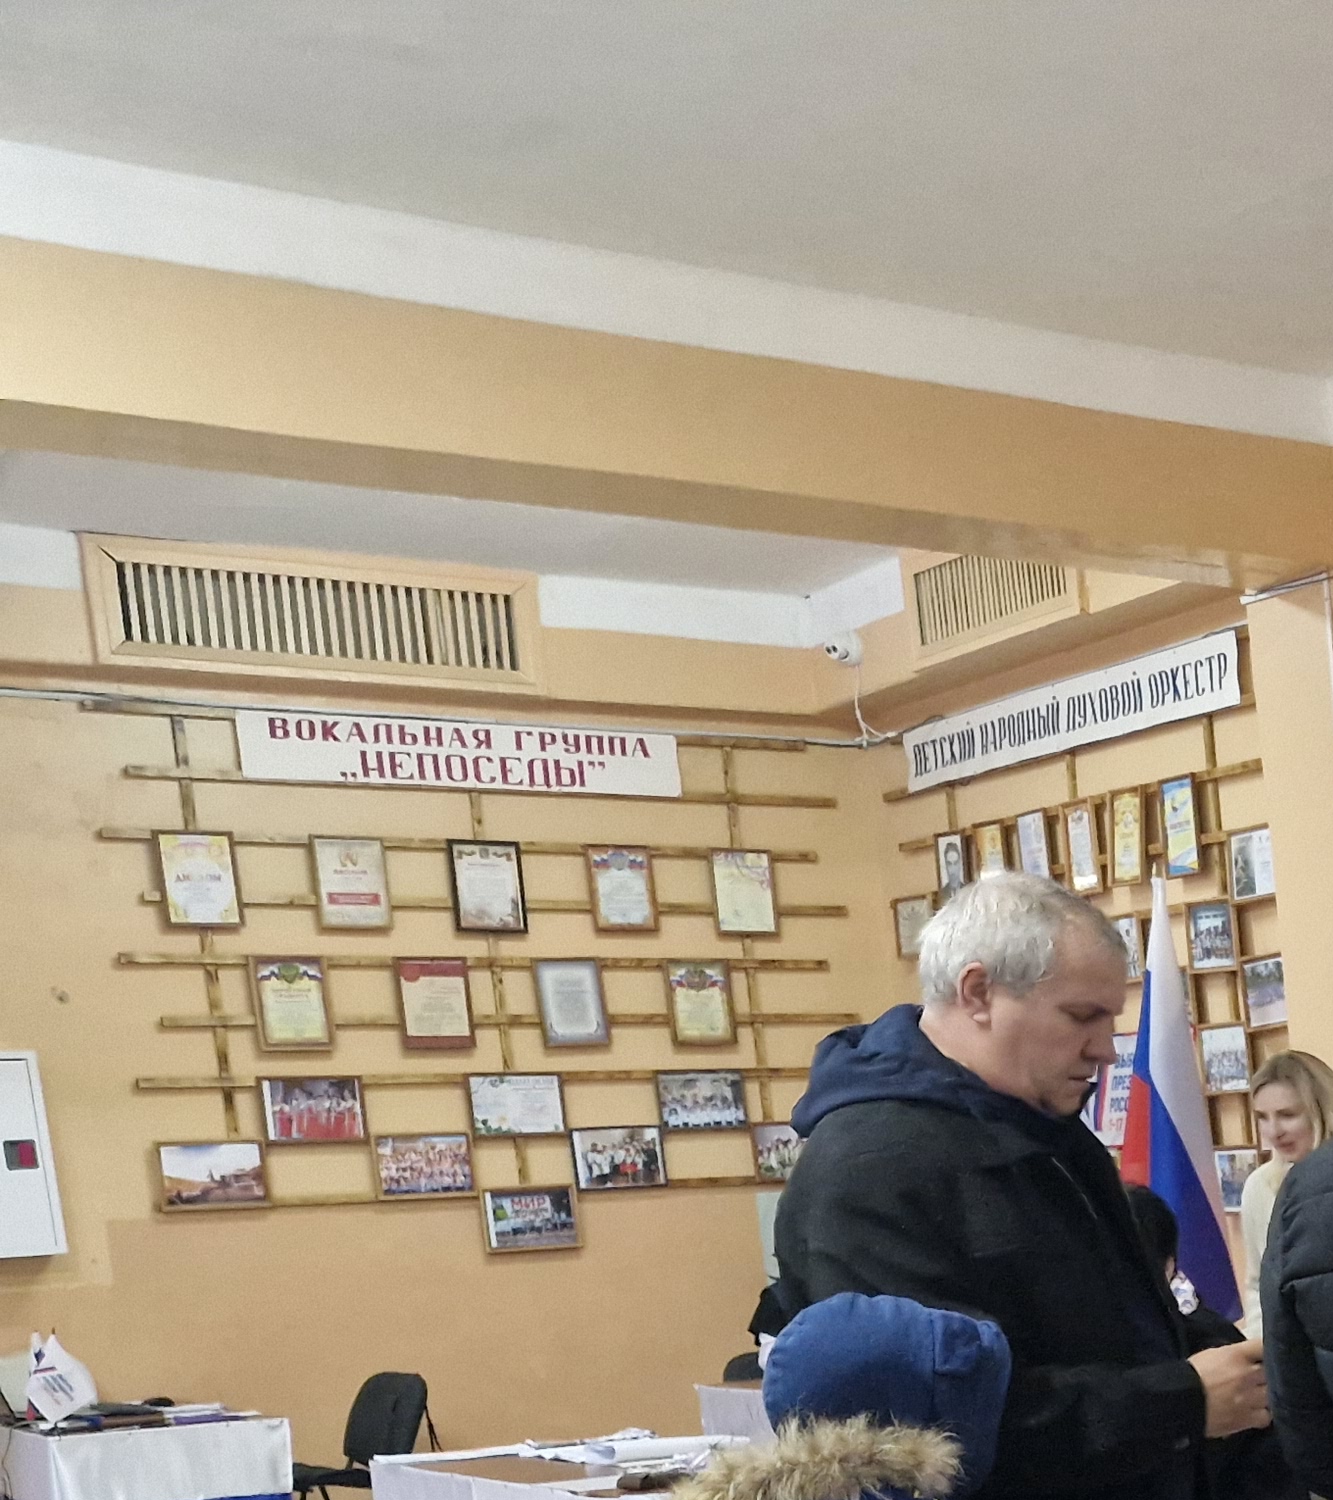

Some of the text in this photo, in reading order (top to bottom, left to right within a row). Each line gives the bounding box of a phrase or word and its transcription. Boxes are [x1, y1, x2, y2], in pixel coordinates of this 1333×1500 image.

[268, 717, 652, 759] ВОКАЛЬНАЯ ГРУППА
[913, 652, 1228, 777] ДЕТСКИЙ НАРОДНЫЙ ДУХОВОЙ ОРКЕСТР
